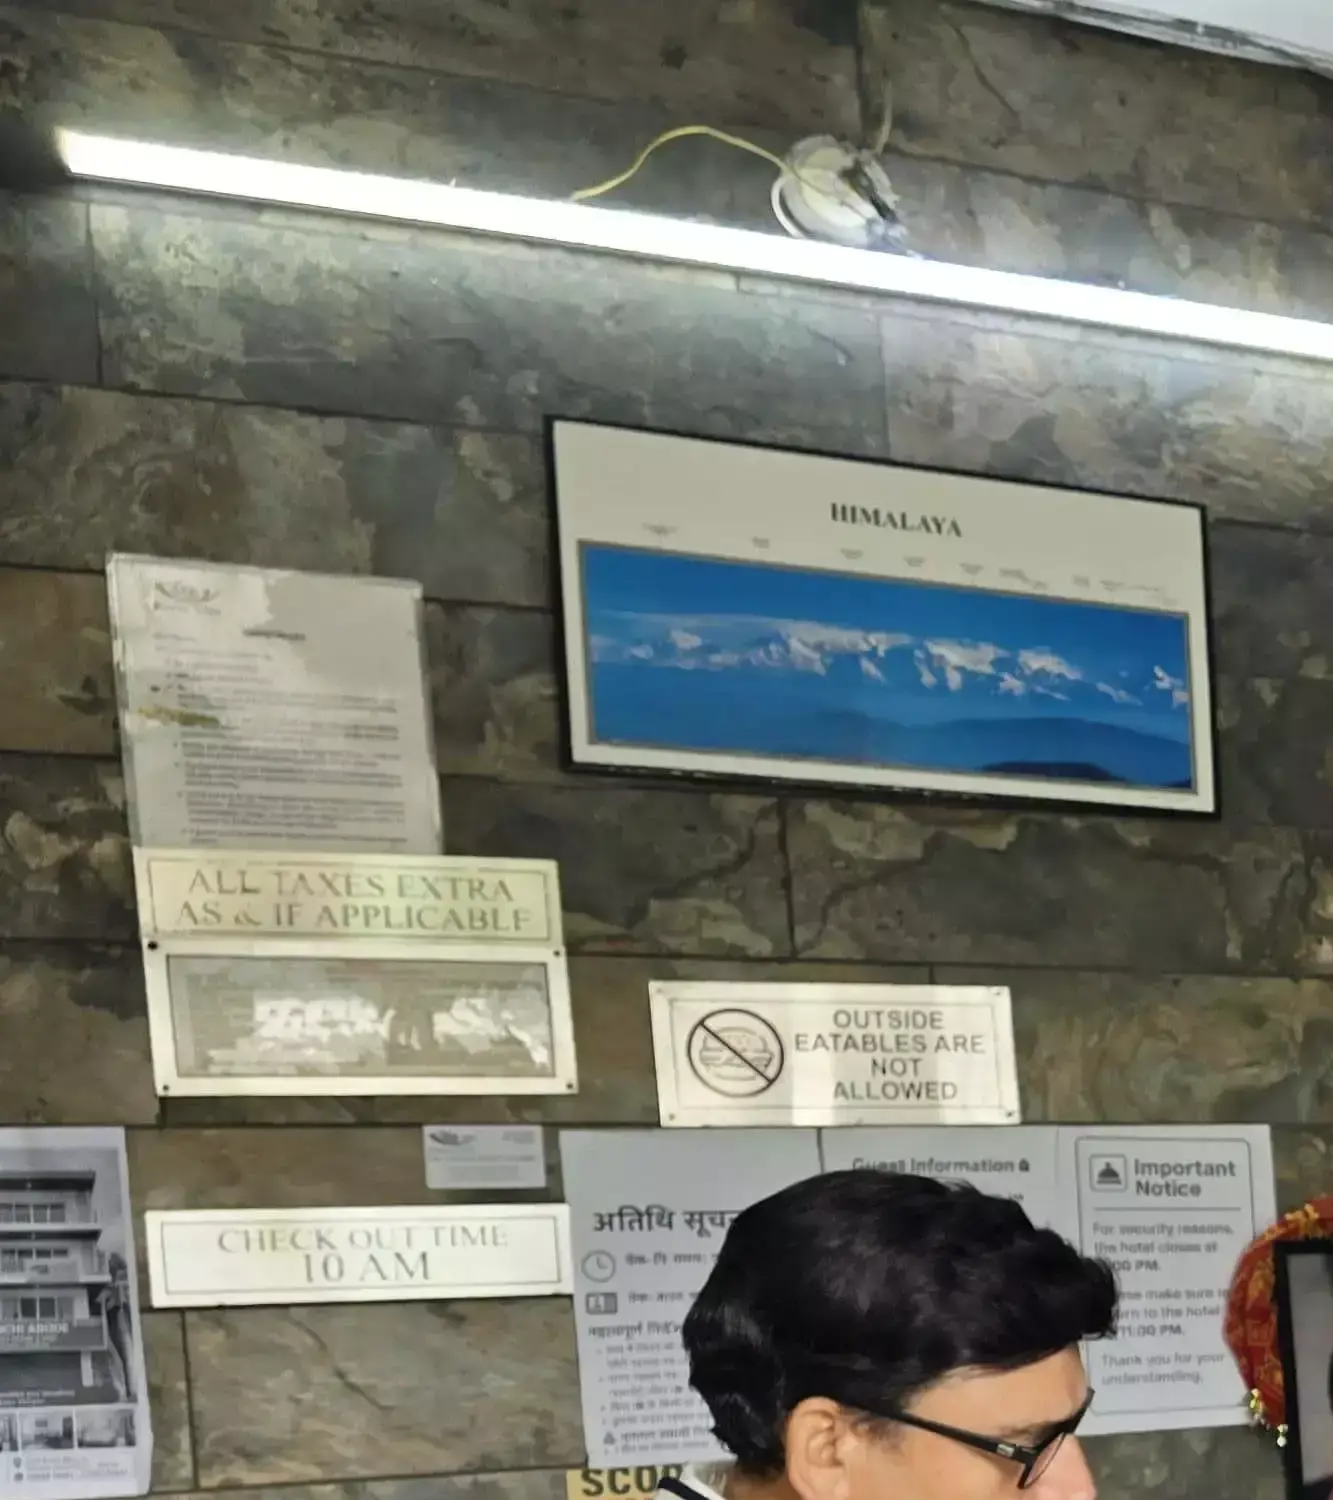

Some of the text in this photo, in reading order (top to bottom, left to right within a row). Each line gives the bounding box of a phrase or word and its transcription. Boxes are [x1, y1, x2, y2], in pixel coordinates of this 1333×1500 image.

[830, 502, 963, 538] HIMALAYA
[188, 867, 514, 902] ALL TAXES EXTRA
[178, 901, 222, 926] AS
[233, 906, 262, 927] &
[274, 903, 304, 928] IF
[832, 1009, 945, 1031] OUTSIDE
[794, 1033, 986, 1055] EATABLES ARE
[871, 1057, 923, 1076] NOT
[832, 1080, 958, 1101] ALLOWED
[911, 1158, 1015, 1173] Information
[1134, 1159, 1237, 1178] Important
[1135, 1179, 1202, 1198] Notice
[593, 1204, 676, 1233] अतिथि
[1093, 1222, 1114, 1236] For
[1119, 1222, 1174, 1237] security
[217, 1224, 509, 1255] CHECK OUT TIME
[1120, 1241, 1154, 1253] hotel
[1205, 1240, 1218, 1253] at
[301, 1250, 432, 1284] 10 AM
[1145, 1288, 1182, 1300] make
[1185, 1288, 1214, 1300] sure
[1144, 1307, 1158, 1319] to
[1161, 1306, 1183, 1318] the
[1186, 1304, 1220, 1317] hotel
[1102, 1351, 1225, 1368] Thank you for your
[1101, 1369, 1204, 1386] understanding.
